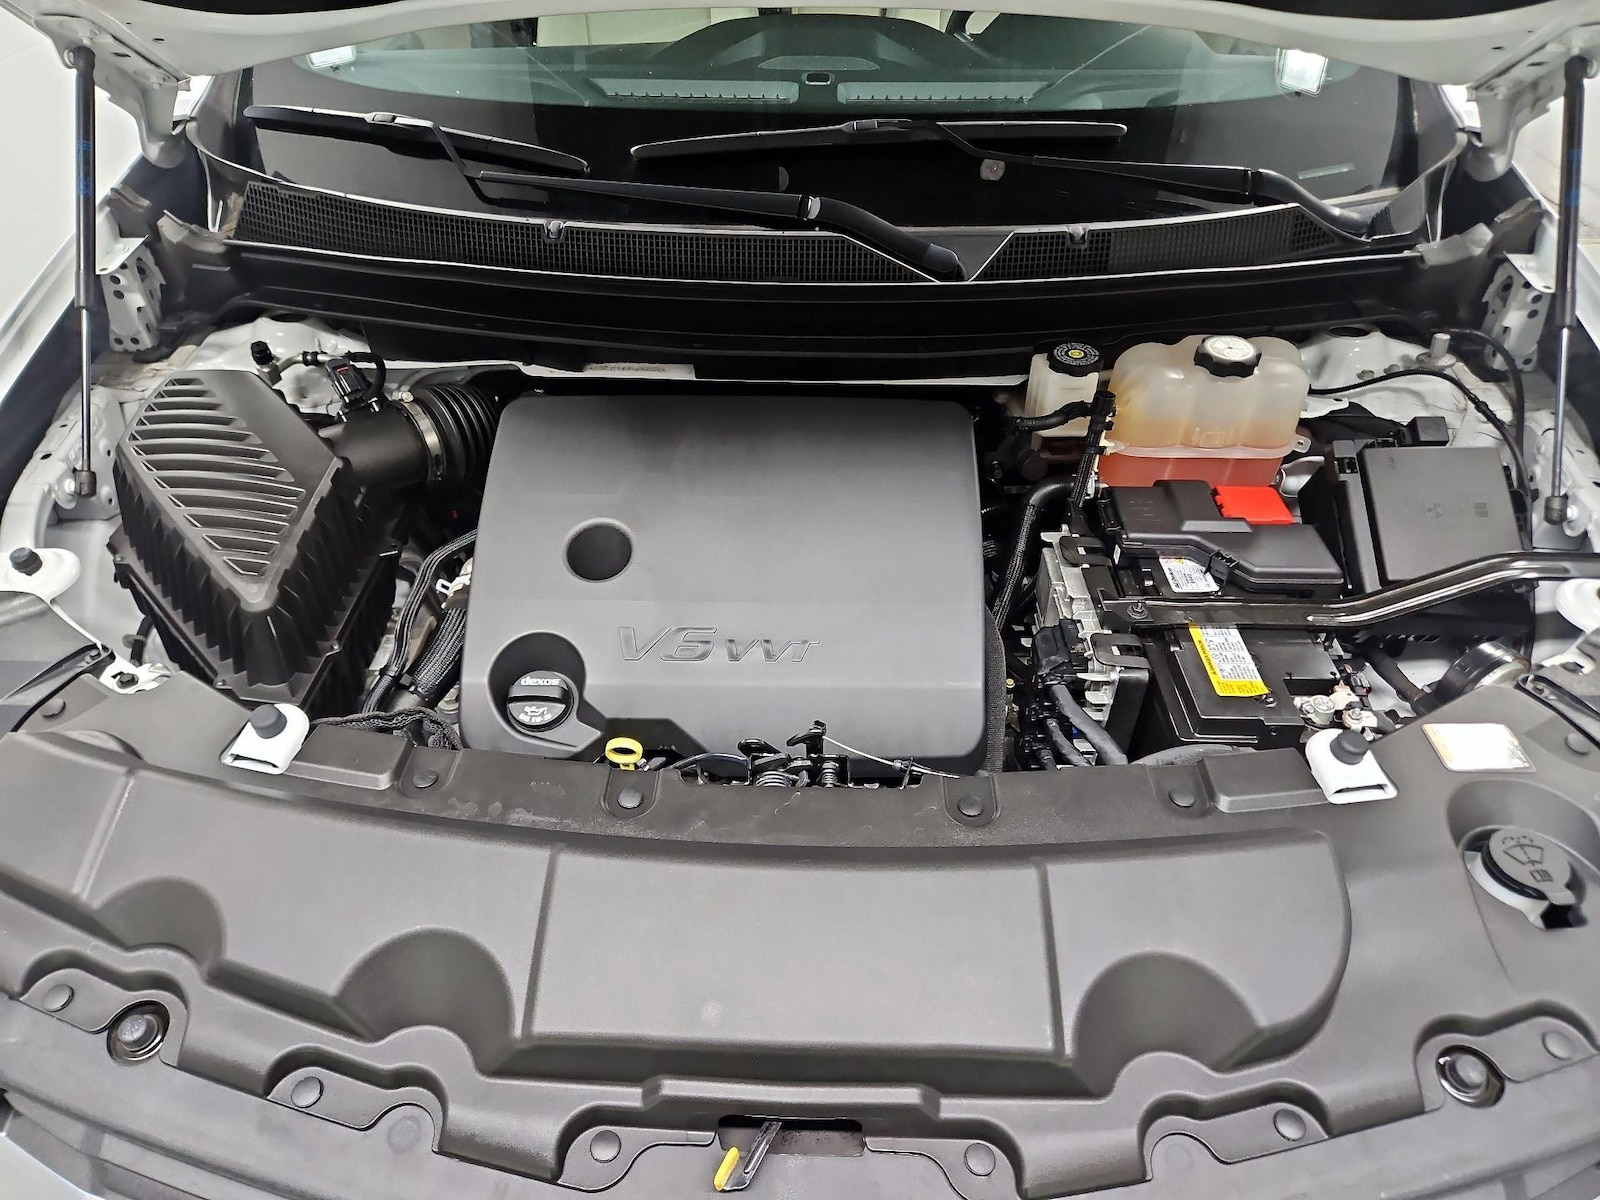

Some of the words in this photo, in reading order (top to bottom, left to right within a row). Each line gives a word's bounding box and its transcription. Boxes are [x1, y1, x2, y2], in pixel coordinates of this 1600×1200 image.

[617, 625, 718, 662] V6
[724, 638, 821, 663] VVT
[521, 676, 561, 686] dexos
